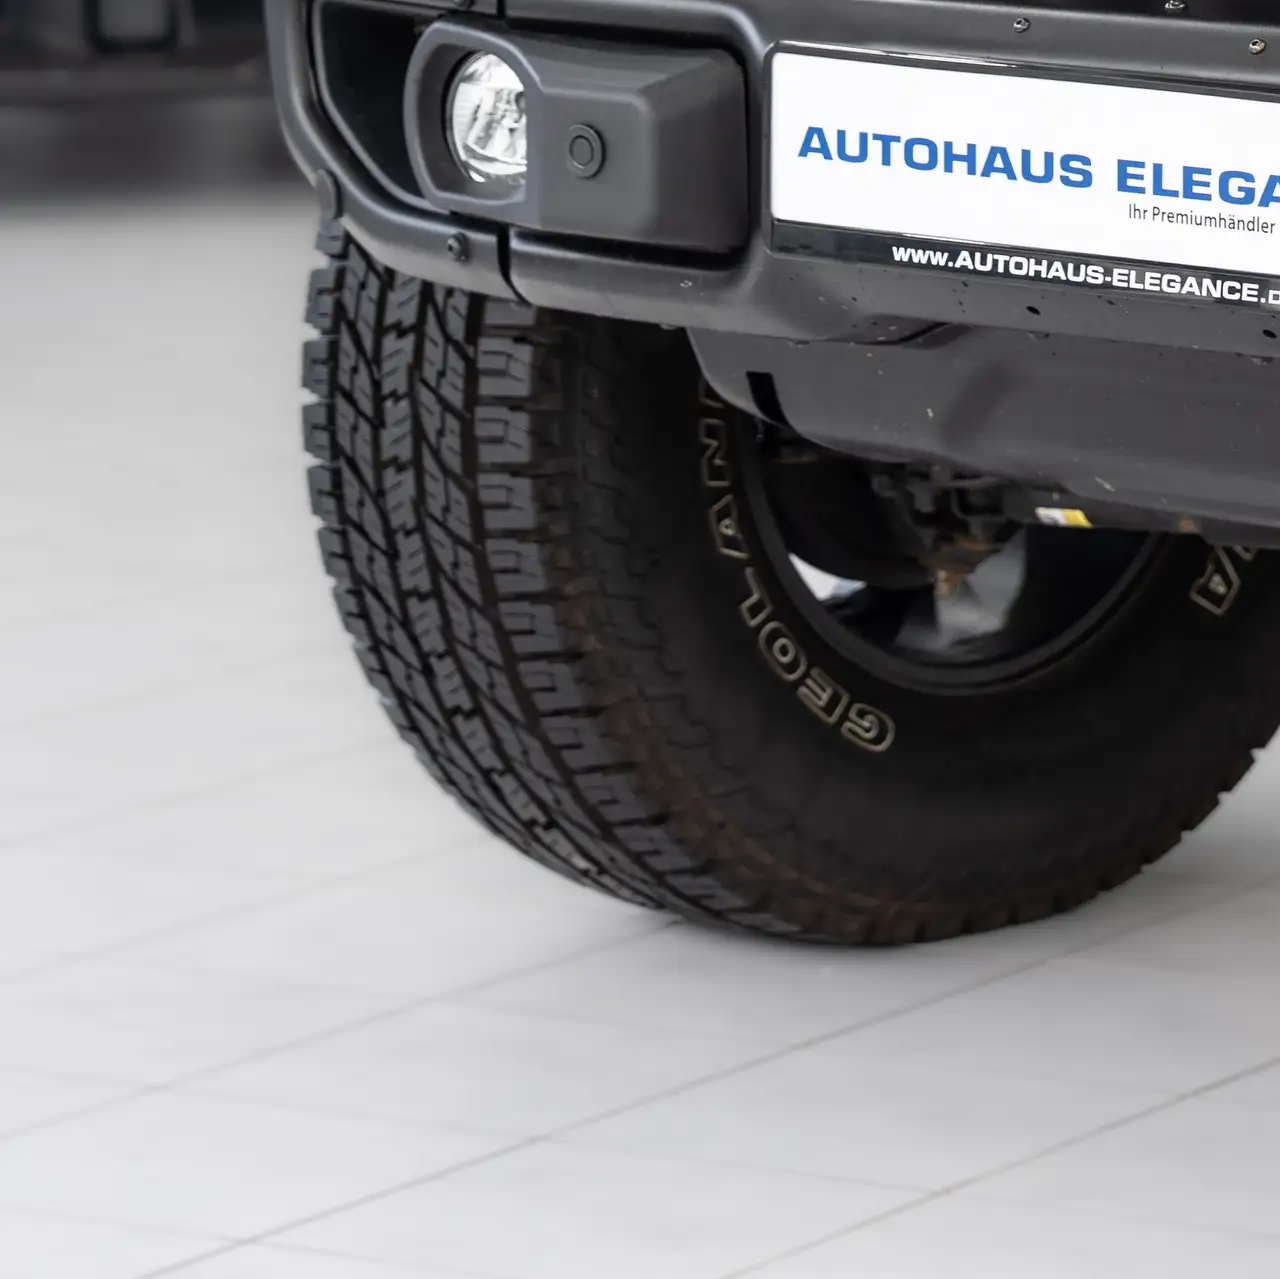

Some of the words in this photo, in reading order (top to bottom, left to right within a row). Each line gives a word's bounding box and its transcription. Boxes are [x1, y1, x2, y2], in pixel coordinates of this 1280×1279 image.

[798, 125, 1093, 189] AUTOHAUS
[1128, 203, 1149, 221] Ihr
[1152, 206, 1276, 235] Premiumhändler
